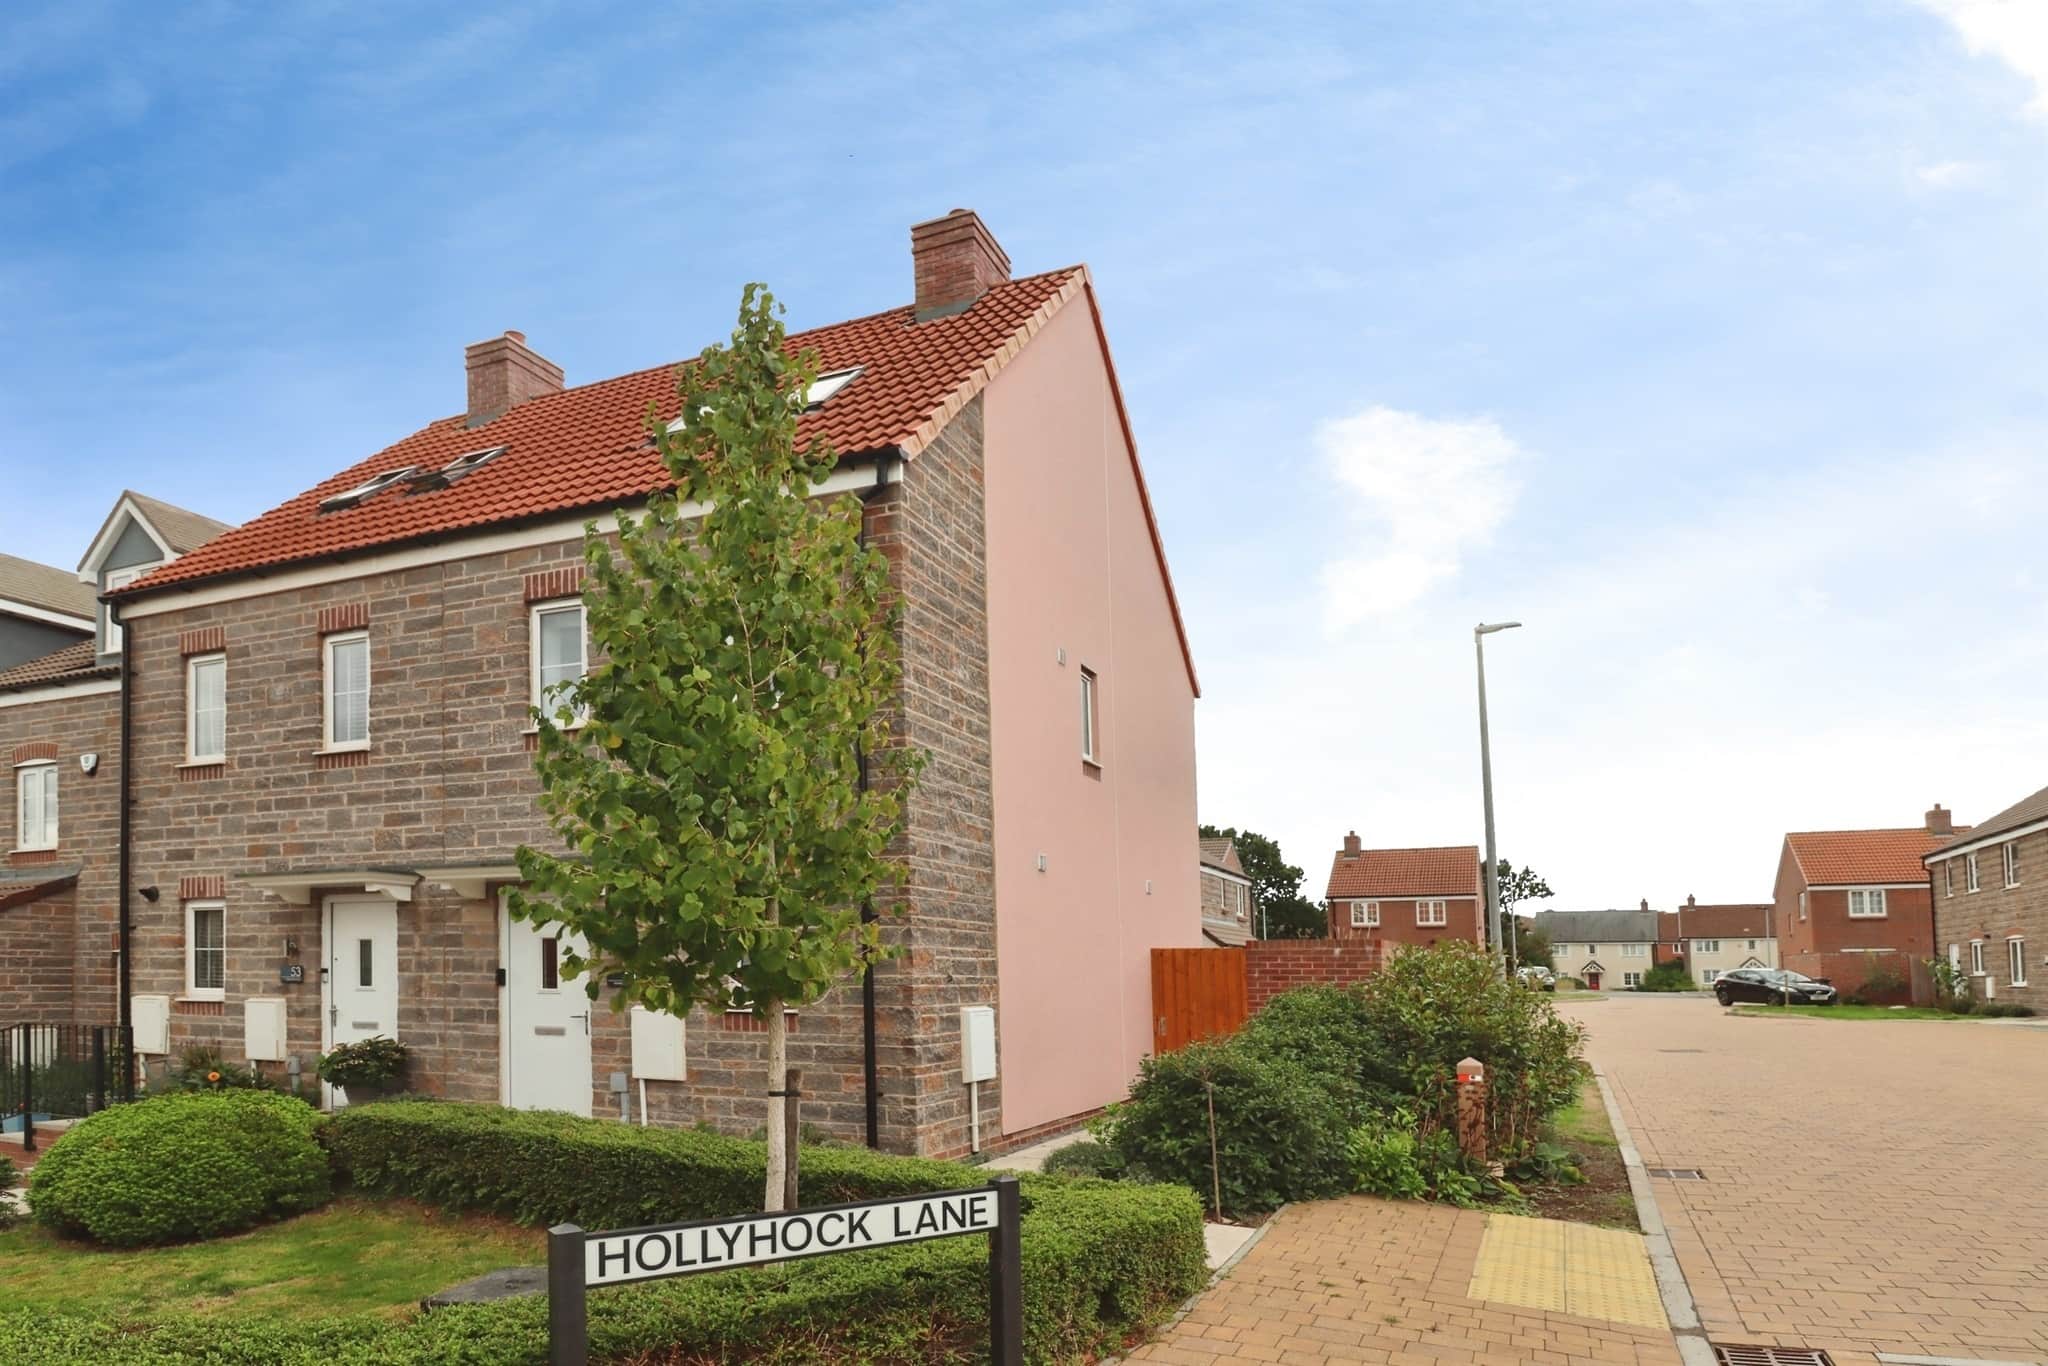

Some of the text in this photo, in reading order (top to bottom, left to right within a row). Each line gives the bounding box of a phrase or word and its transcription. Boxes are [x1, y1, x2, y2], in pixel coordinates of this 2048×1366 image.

[290, 966, 302, 977] 53
[598, 1196, 988, 1277] HOLLYHOCK LANE
